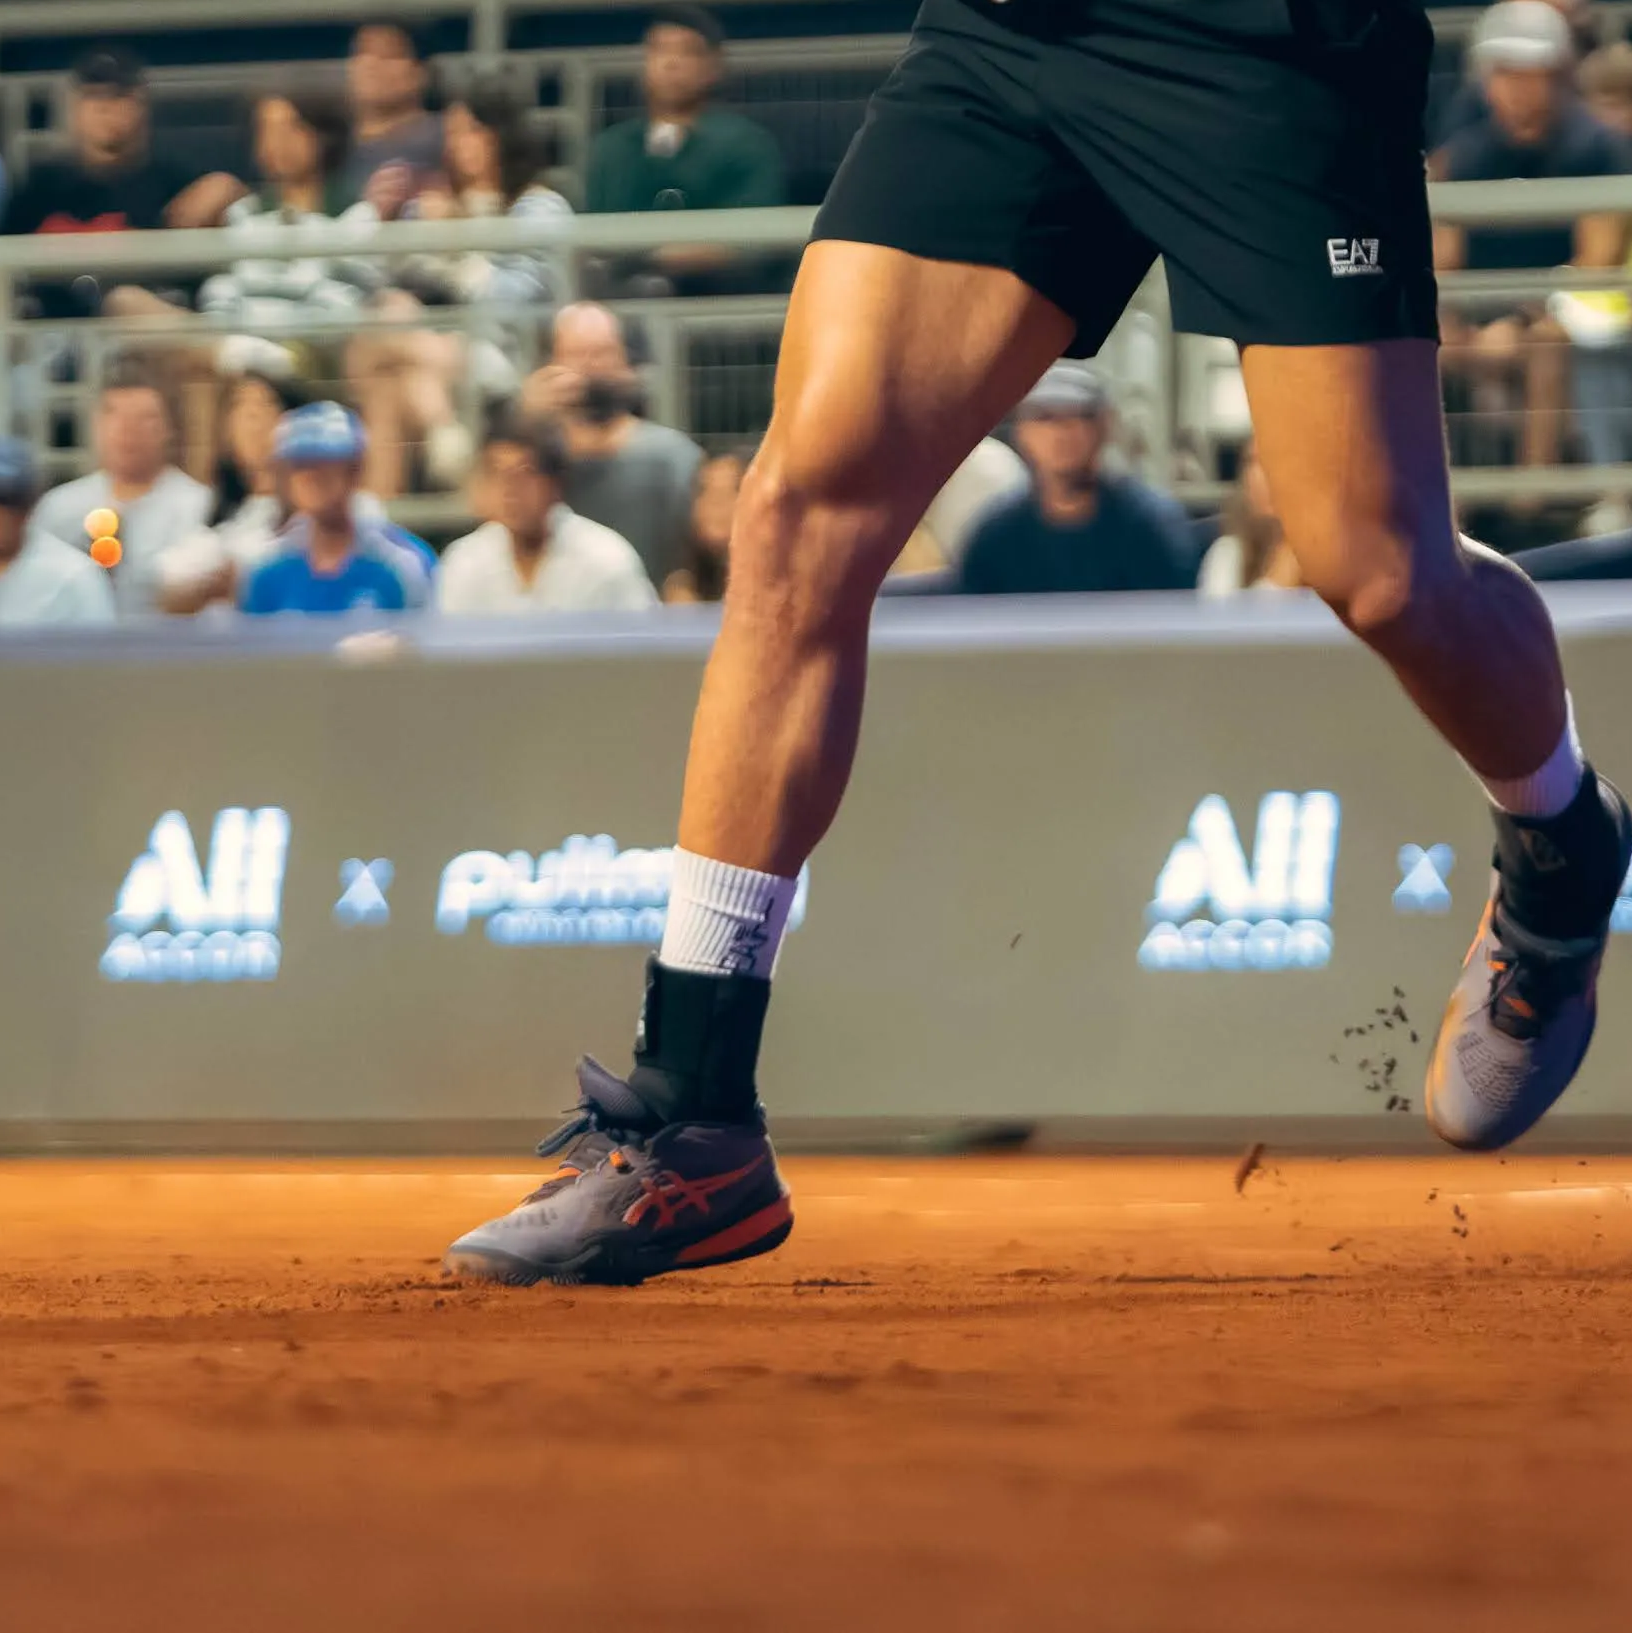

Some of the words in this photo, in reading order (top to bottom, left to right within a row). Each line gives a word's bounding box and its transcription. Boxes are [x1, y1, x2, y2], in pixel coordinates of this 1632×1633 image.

[1326, 238, 1380, 266] EA7
[106, 805, 291, 934] All
[1144, 789, 1342, 924] All
